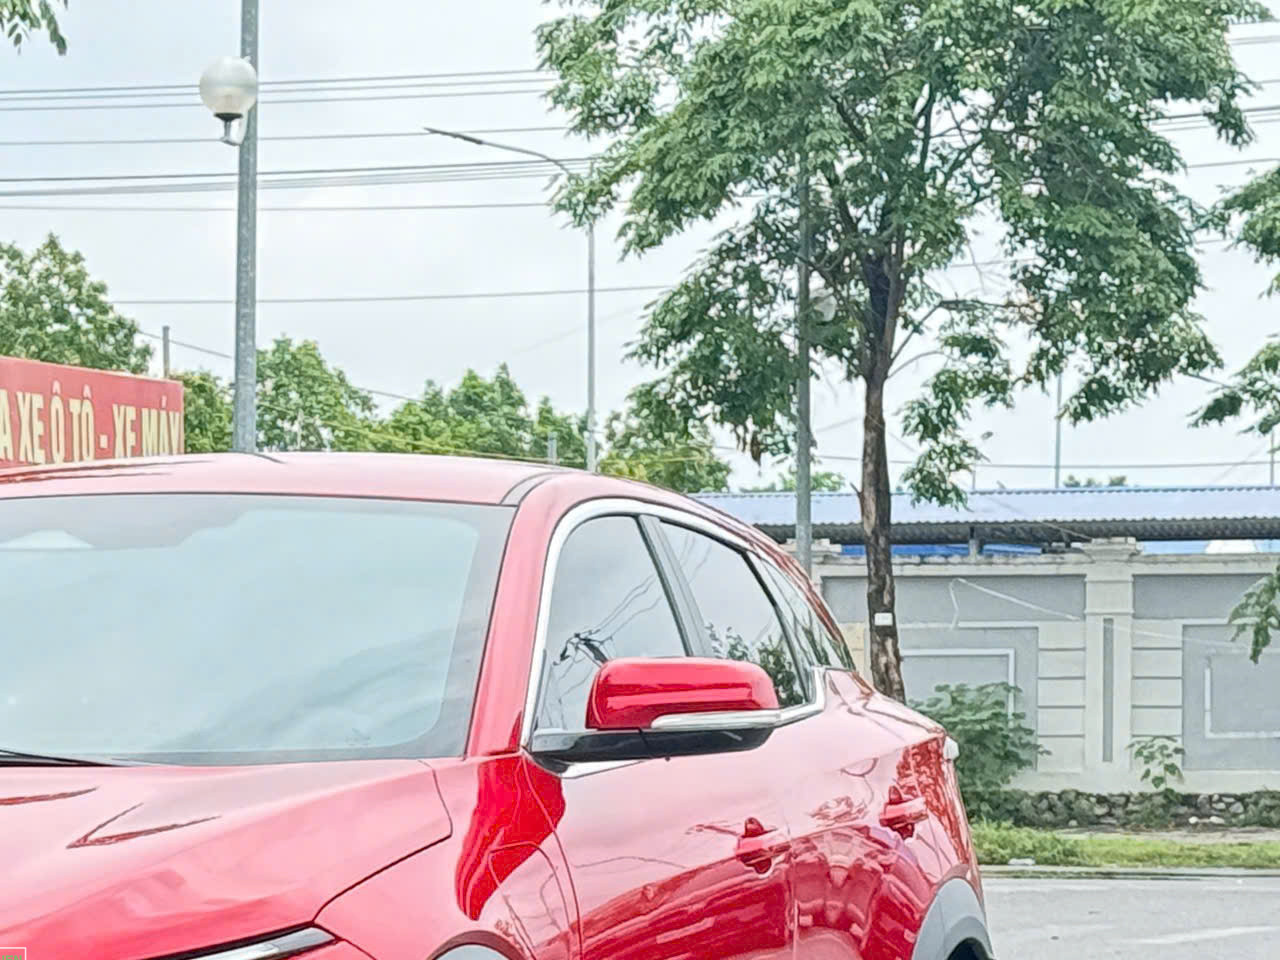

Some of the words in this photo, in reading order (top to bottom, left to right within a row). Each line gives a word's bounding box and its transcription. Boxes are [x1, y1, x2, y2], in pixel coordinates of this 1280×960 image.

[16, 391, 46, 464] XE
[51, 380, 65, 464] Ô
[69, 384, 95, 462] TÔ
[141, 395, 180, 457] MÁY
